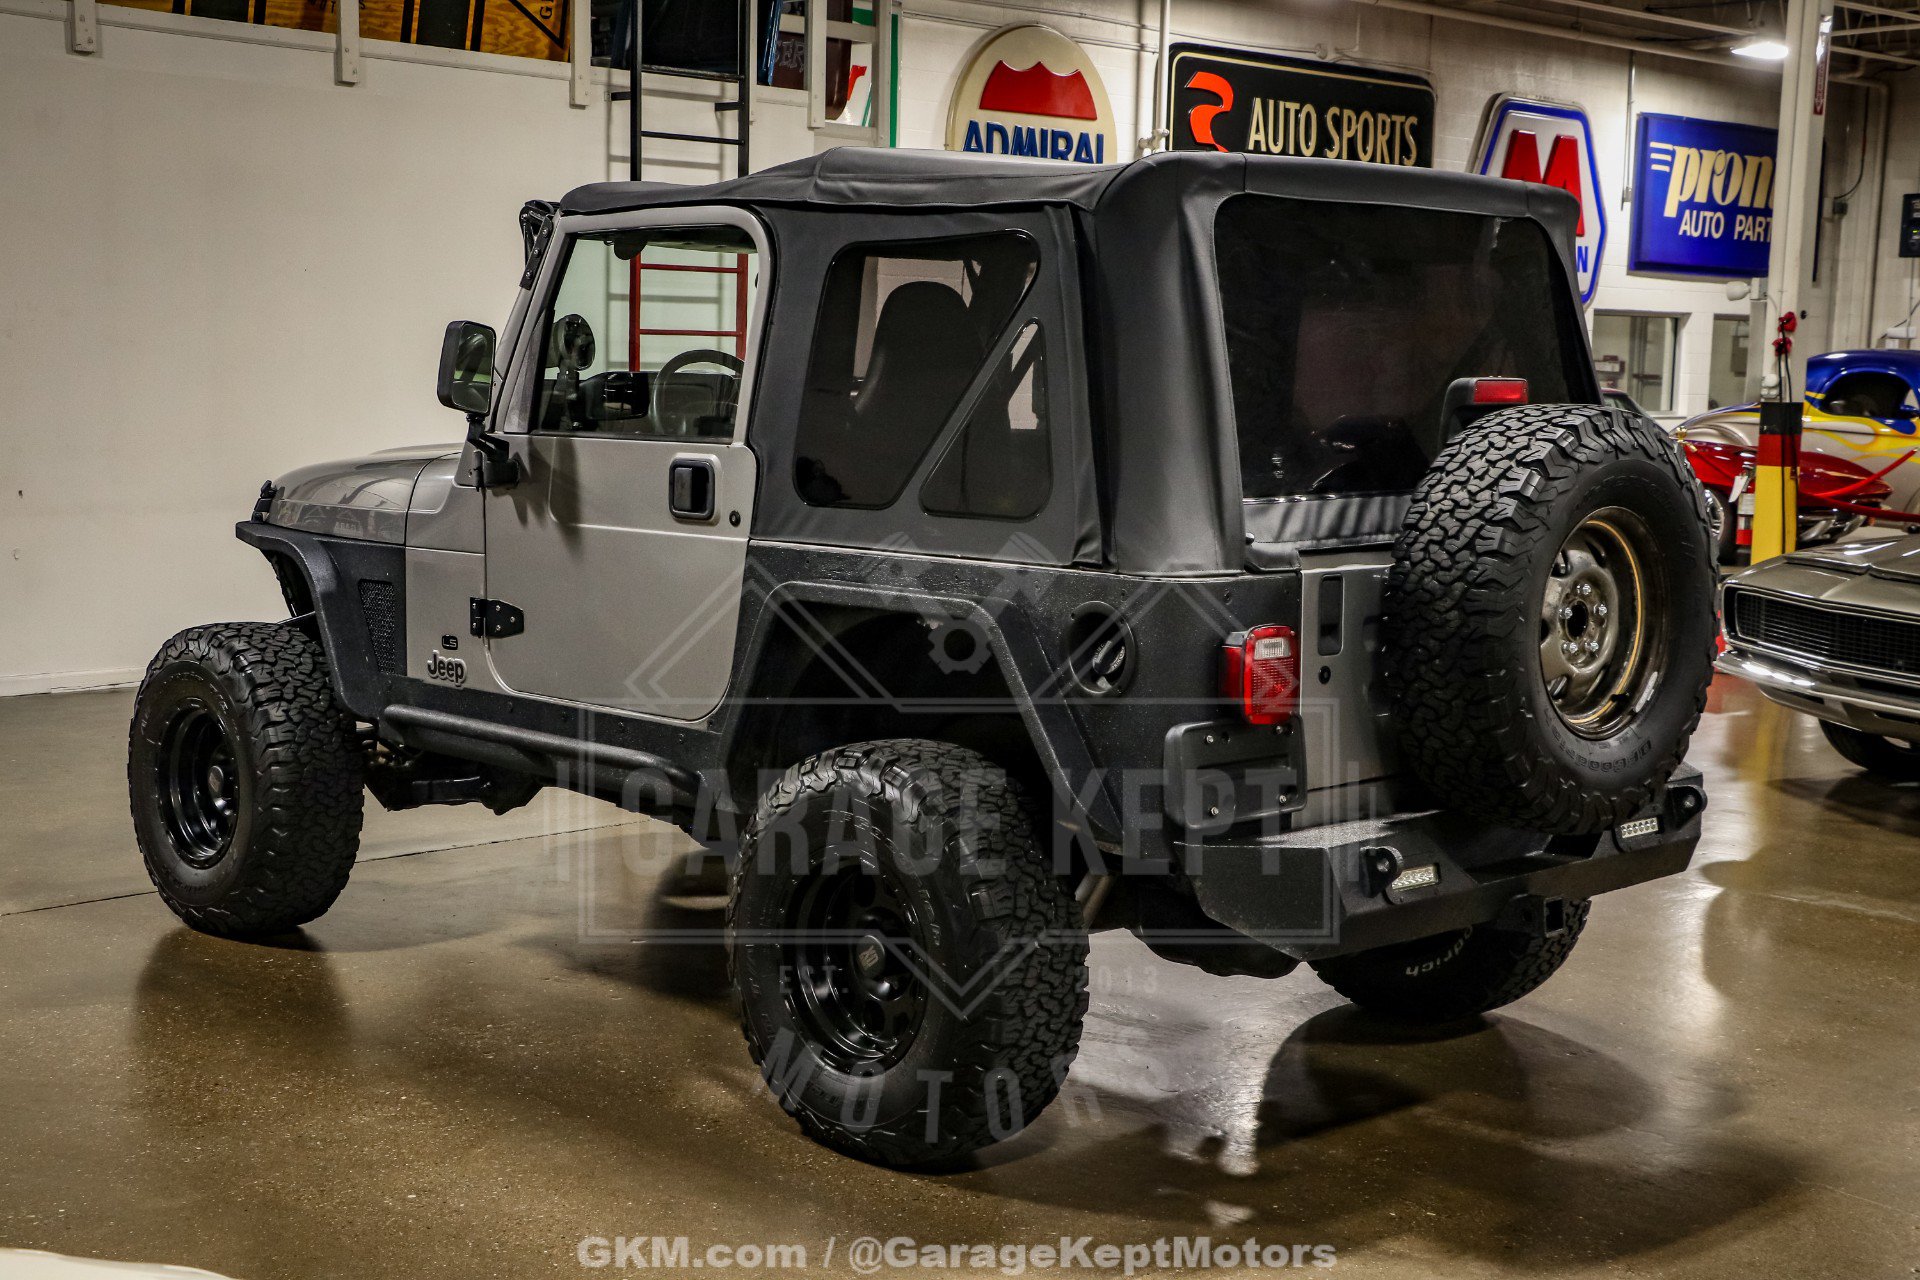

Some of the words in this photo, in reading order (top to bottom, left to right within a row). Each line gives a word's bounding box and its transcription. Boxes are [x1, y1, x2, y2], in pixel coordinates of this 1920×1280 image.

[1248, 97, 1318, 157] AUTO
[1324, 106, 1419, 167] SPORTS
[1663, 145, 1777, 218] pron
[1678, 209, 1726, 240] AUTO
[1733, 214, 1774, 243] PART
[427, 650, 467, 687] Jeep
[1405, 926, 1473, 977] odrich
